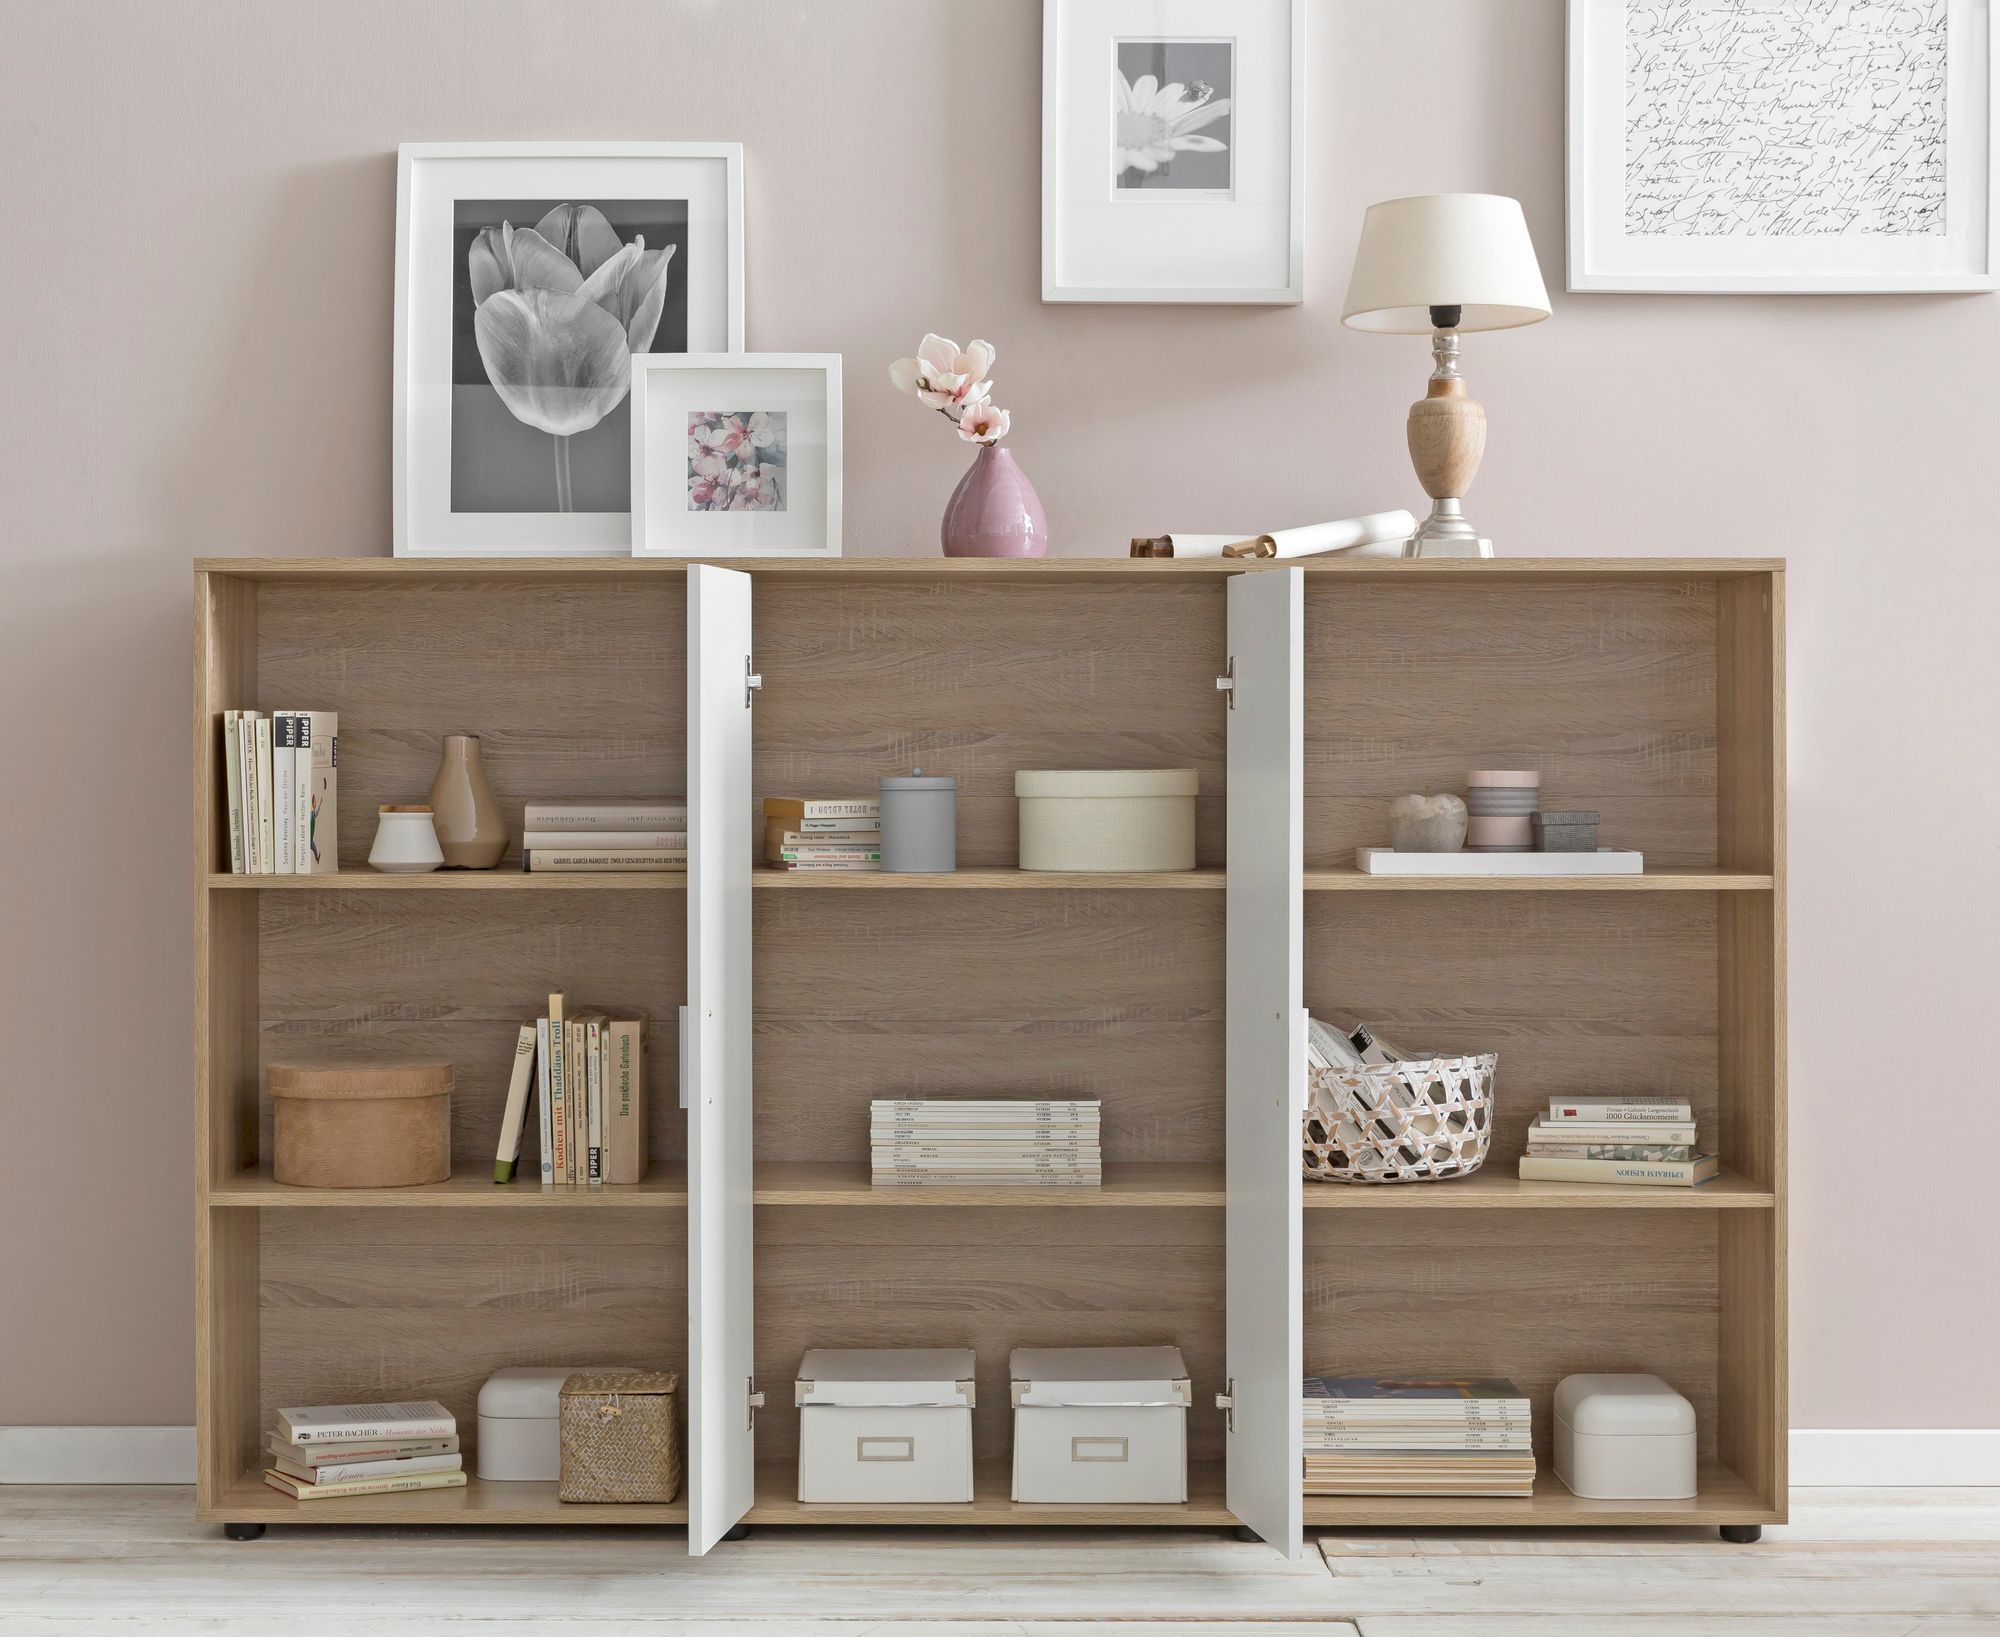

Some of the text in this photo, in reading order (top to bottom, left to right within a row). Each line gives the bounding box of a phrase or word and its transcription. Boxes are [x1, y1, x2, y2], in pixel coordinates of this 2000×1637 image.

[286, 719, 294, 746] PIPER
[301, 720, 309, 747] PIPER
[1358, 1027, 1373, 1045] PIPER
[620, 1034, 629, 1068] Gartenbuch
[552, 1021, 564, 1169] Kochen mit Thaddäus Troll
[620, 1103, 629, 1116] Das
[1623, 1112, 1679, 1121] Glücksmomente
[590, 1148, 598, 1175] PIPER
[1616, 1169, 1684, 1179] EPHRAIM KISHON
[317, 1430, 343, 1438] PETER
